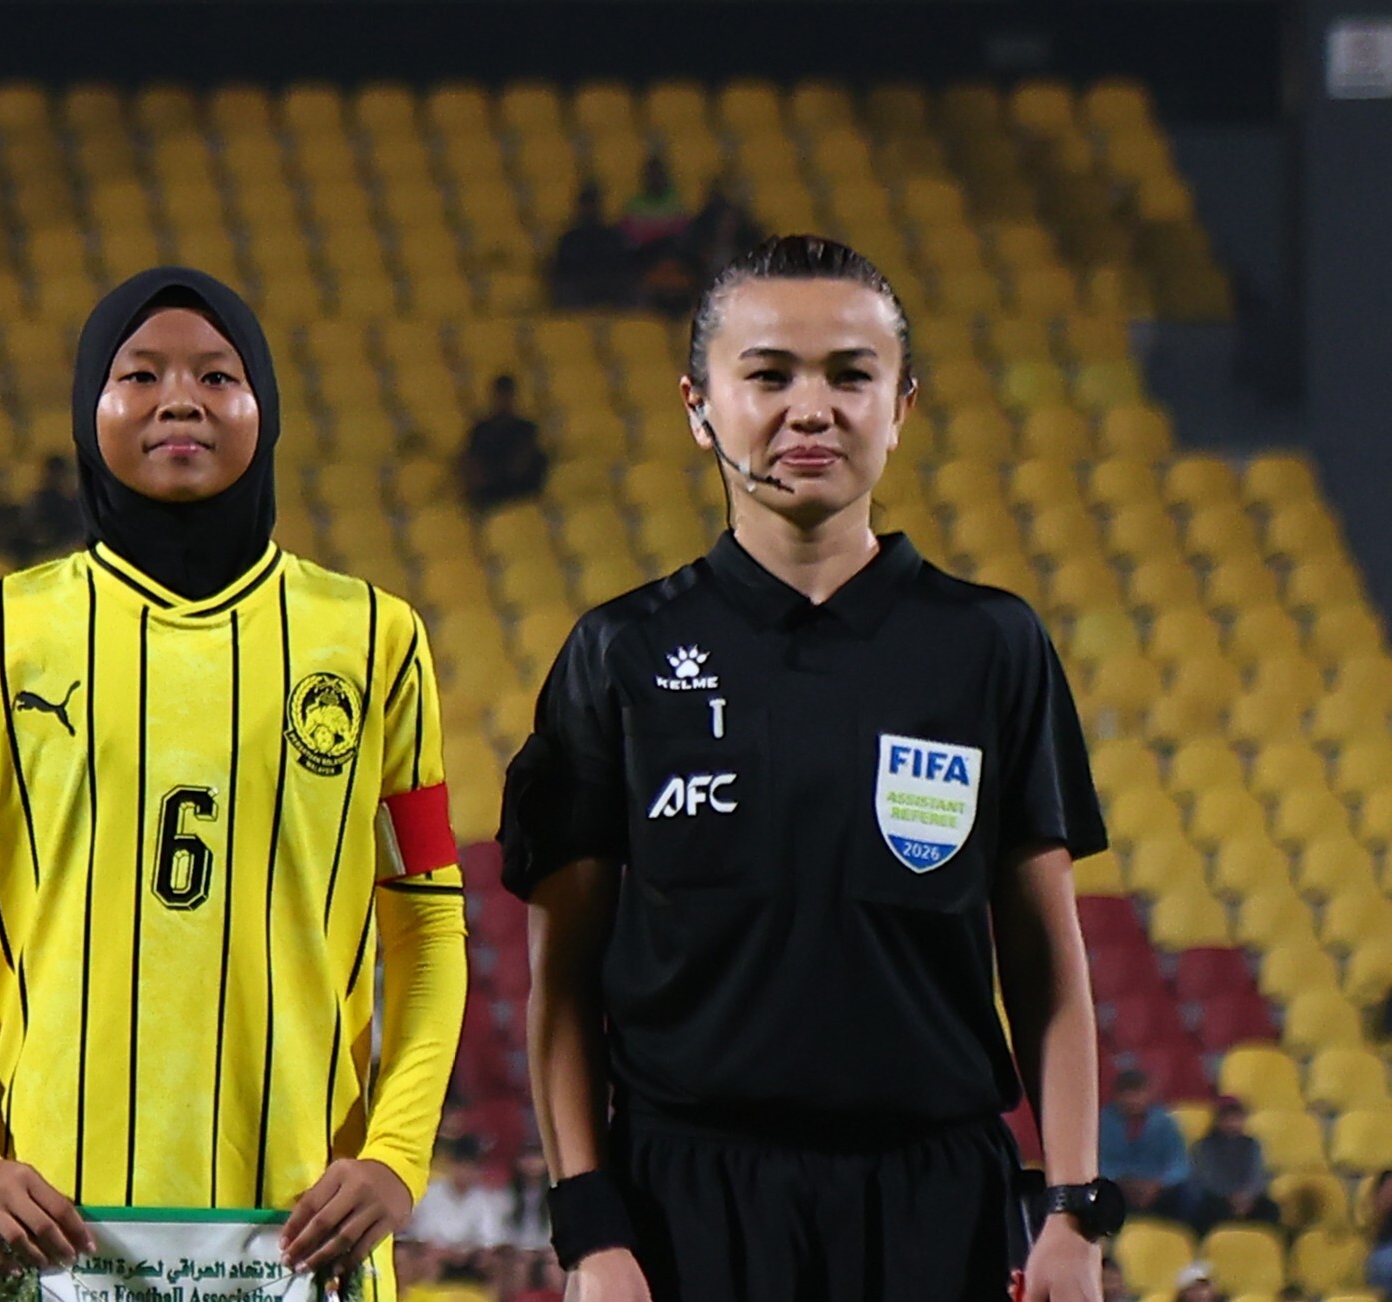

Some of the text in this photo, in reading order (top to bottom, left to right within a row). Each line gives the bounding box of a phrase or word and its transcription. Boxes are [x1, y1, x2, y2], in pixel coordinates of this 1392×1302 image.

[656, 675, 719, 690] KELME
[889, 745, 971, 786] FIFA
[648, 773, 738, 819] AFC
[151, 784, 218, 912] 6
[903, 841, 941, 861] 2026
